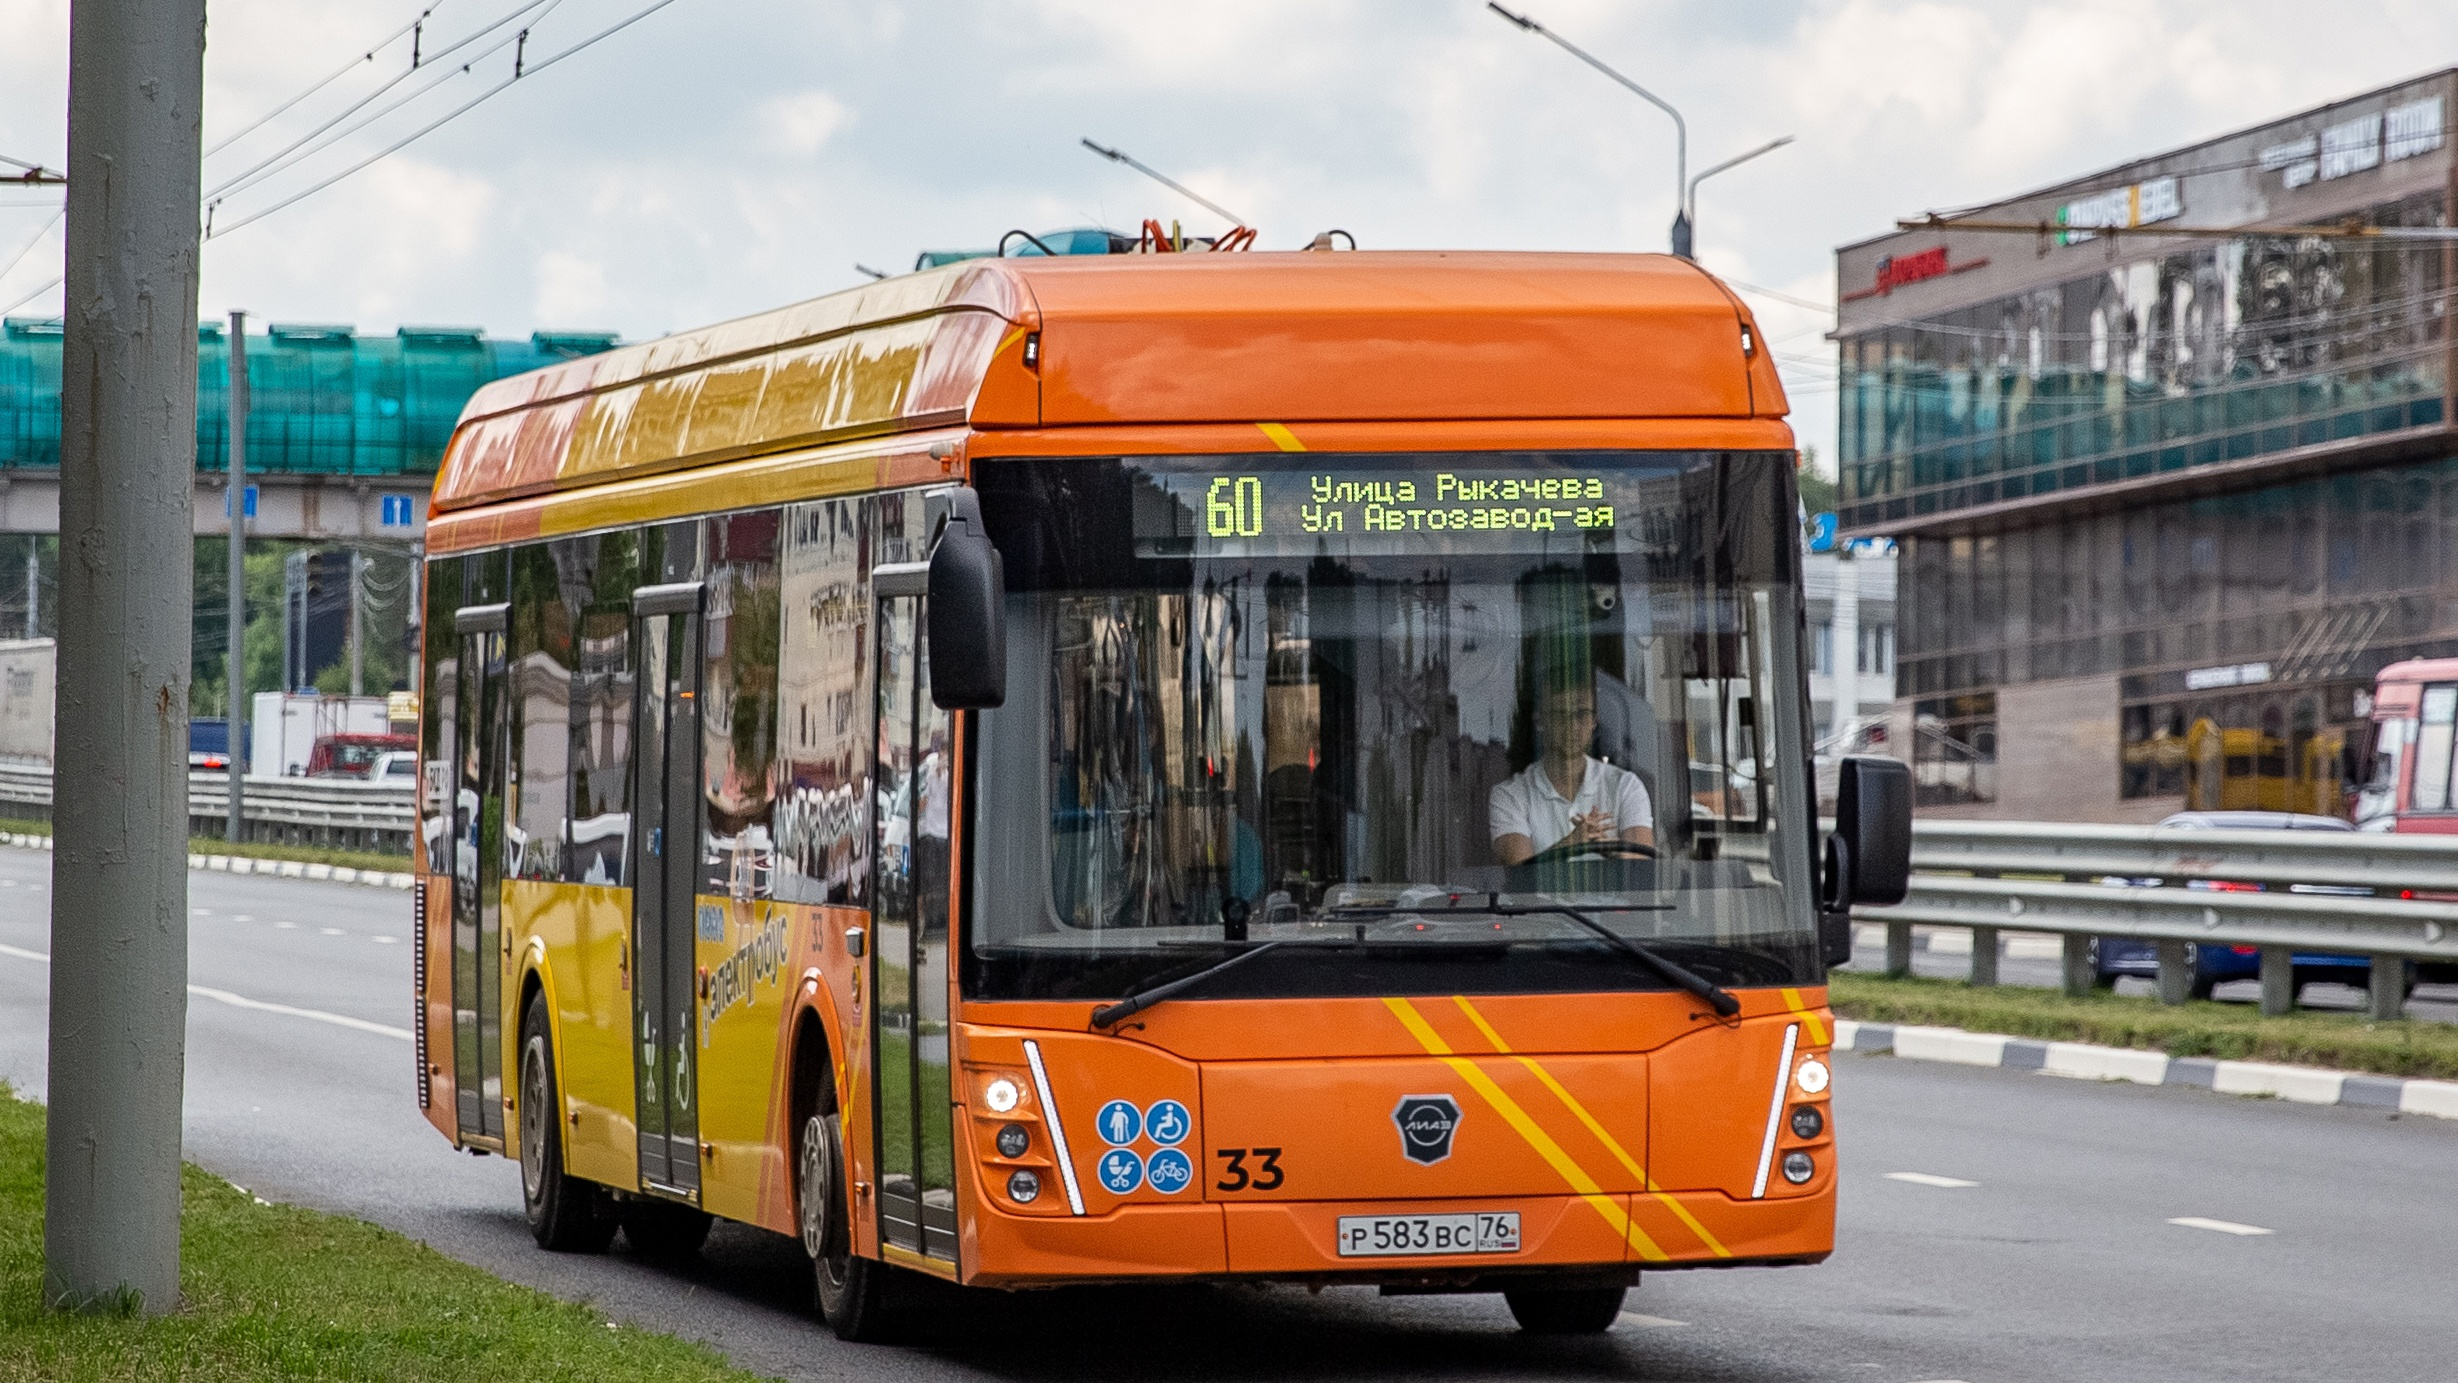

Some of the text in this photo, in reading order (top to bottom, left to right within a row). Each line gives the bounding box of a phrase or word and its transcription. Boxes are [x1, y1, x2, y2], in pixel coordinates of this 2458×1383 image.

[1311, 473, 1603, 506] Улица Рыкачева
[1206, 476, 1262, 537] 60
[1301, 503, 1614, 532] Ул Автозавод-ая
[812, 913, 823, 953] 33
[1404, 1120, 1452, 1130] ЛИАЗ
[1216, 1147, 1285, 1192] 33
[1479, 1238, 1501, 1248] RUS
[1480, 1216, 1510, 1239] 76
